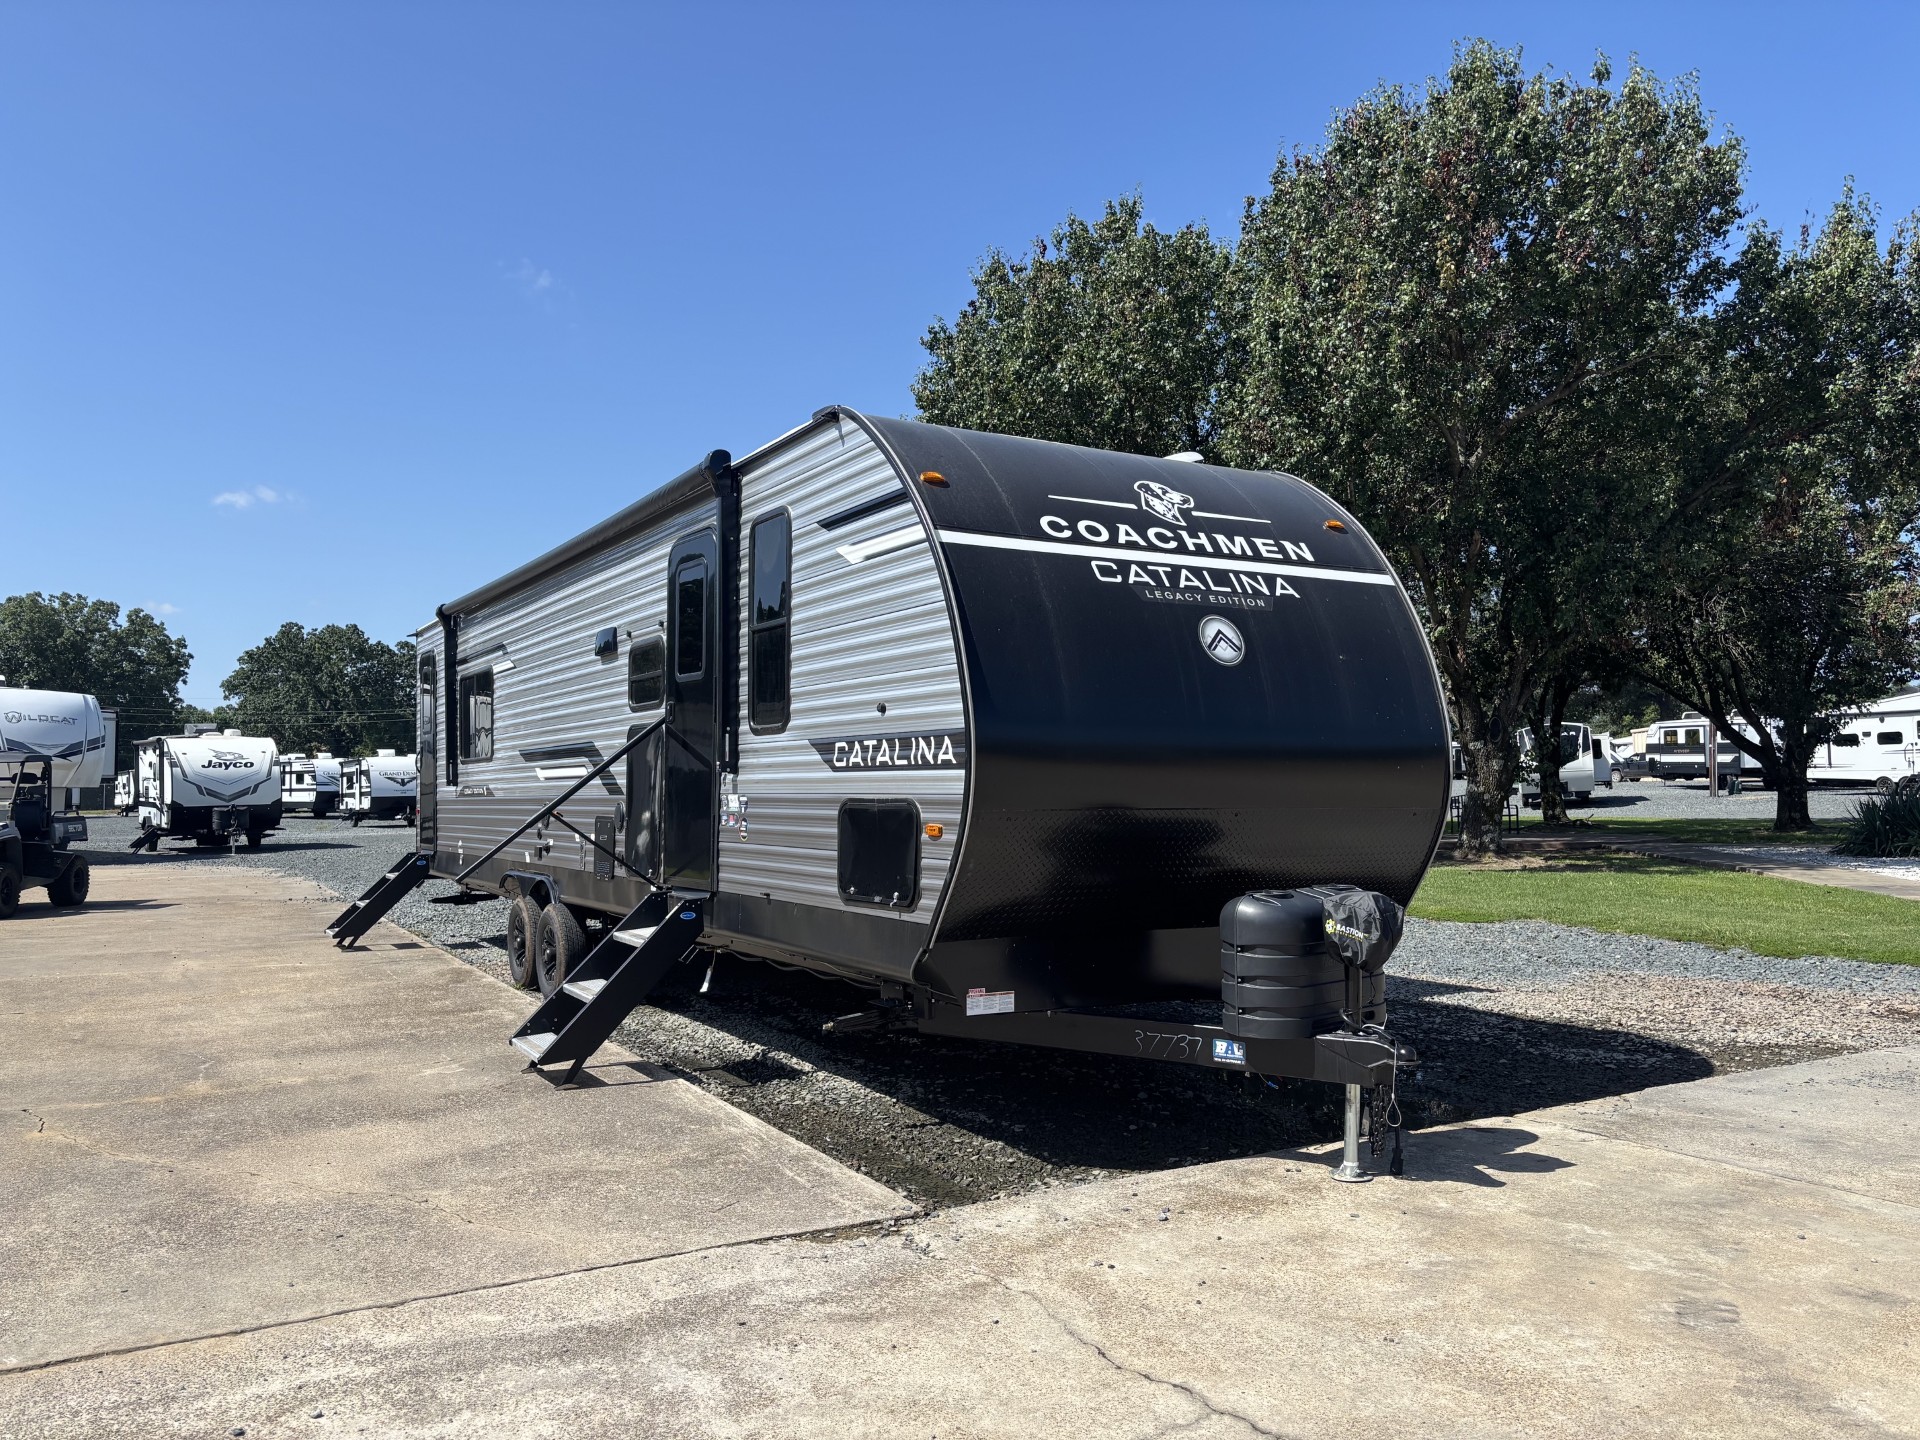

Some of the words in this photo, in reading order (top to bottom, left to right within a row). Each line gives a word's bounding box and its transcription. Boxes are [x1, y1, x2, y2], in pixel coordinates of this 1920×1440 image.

[1039, 515, 1315, 562] COACHMEN
[1091, 560, 1301, 599] CATALINA
[1145, 590, 1202, 602] LEGACY
[1209, 595, 1266, 608] EDITION
[4, 711, 78, 725] WILDCAT
[833, 735, 957, 767] CATALINA
[201, 760, 255, 771] Jayco
[1336, 923, 1364, 939] BASTION
[1135, 1030, 1203, 1058] 37737
